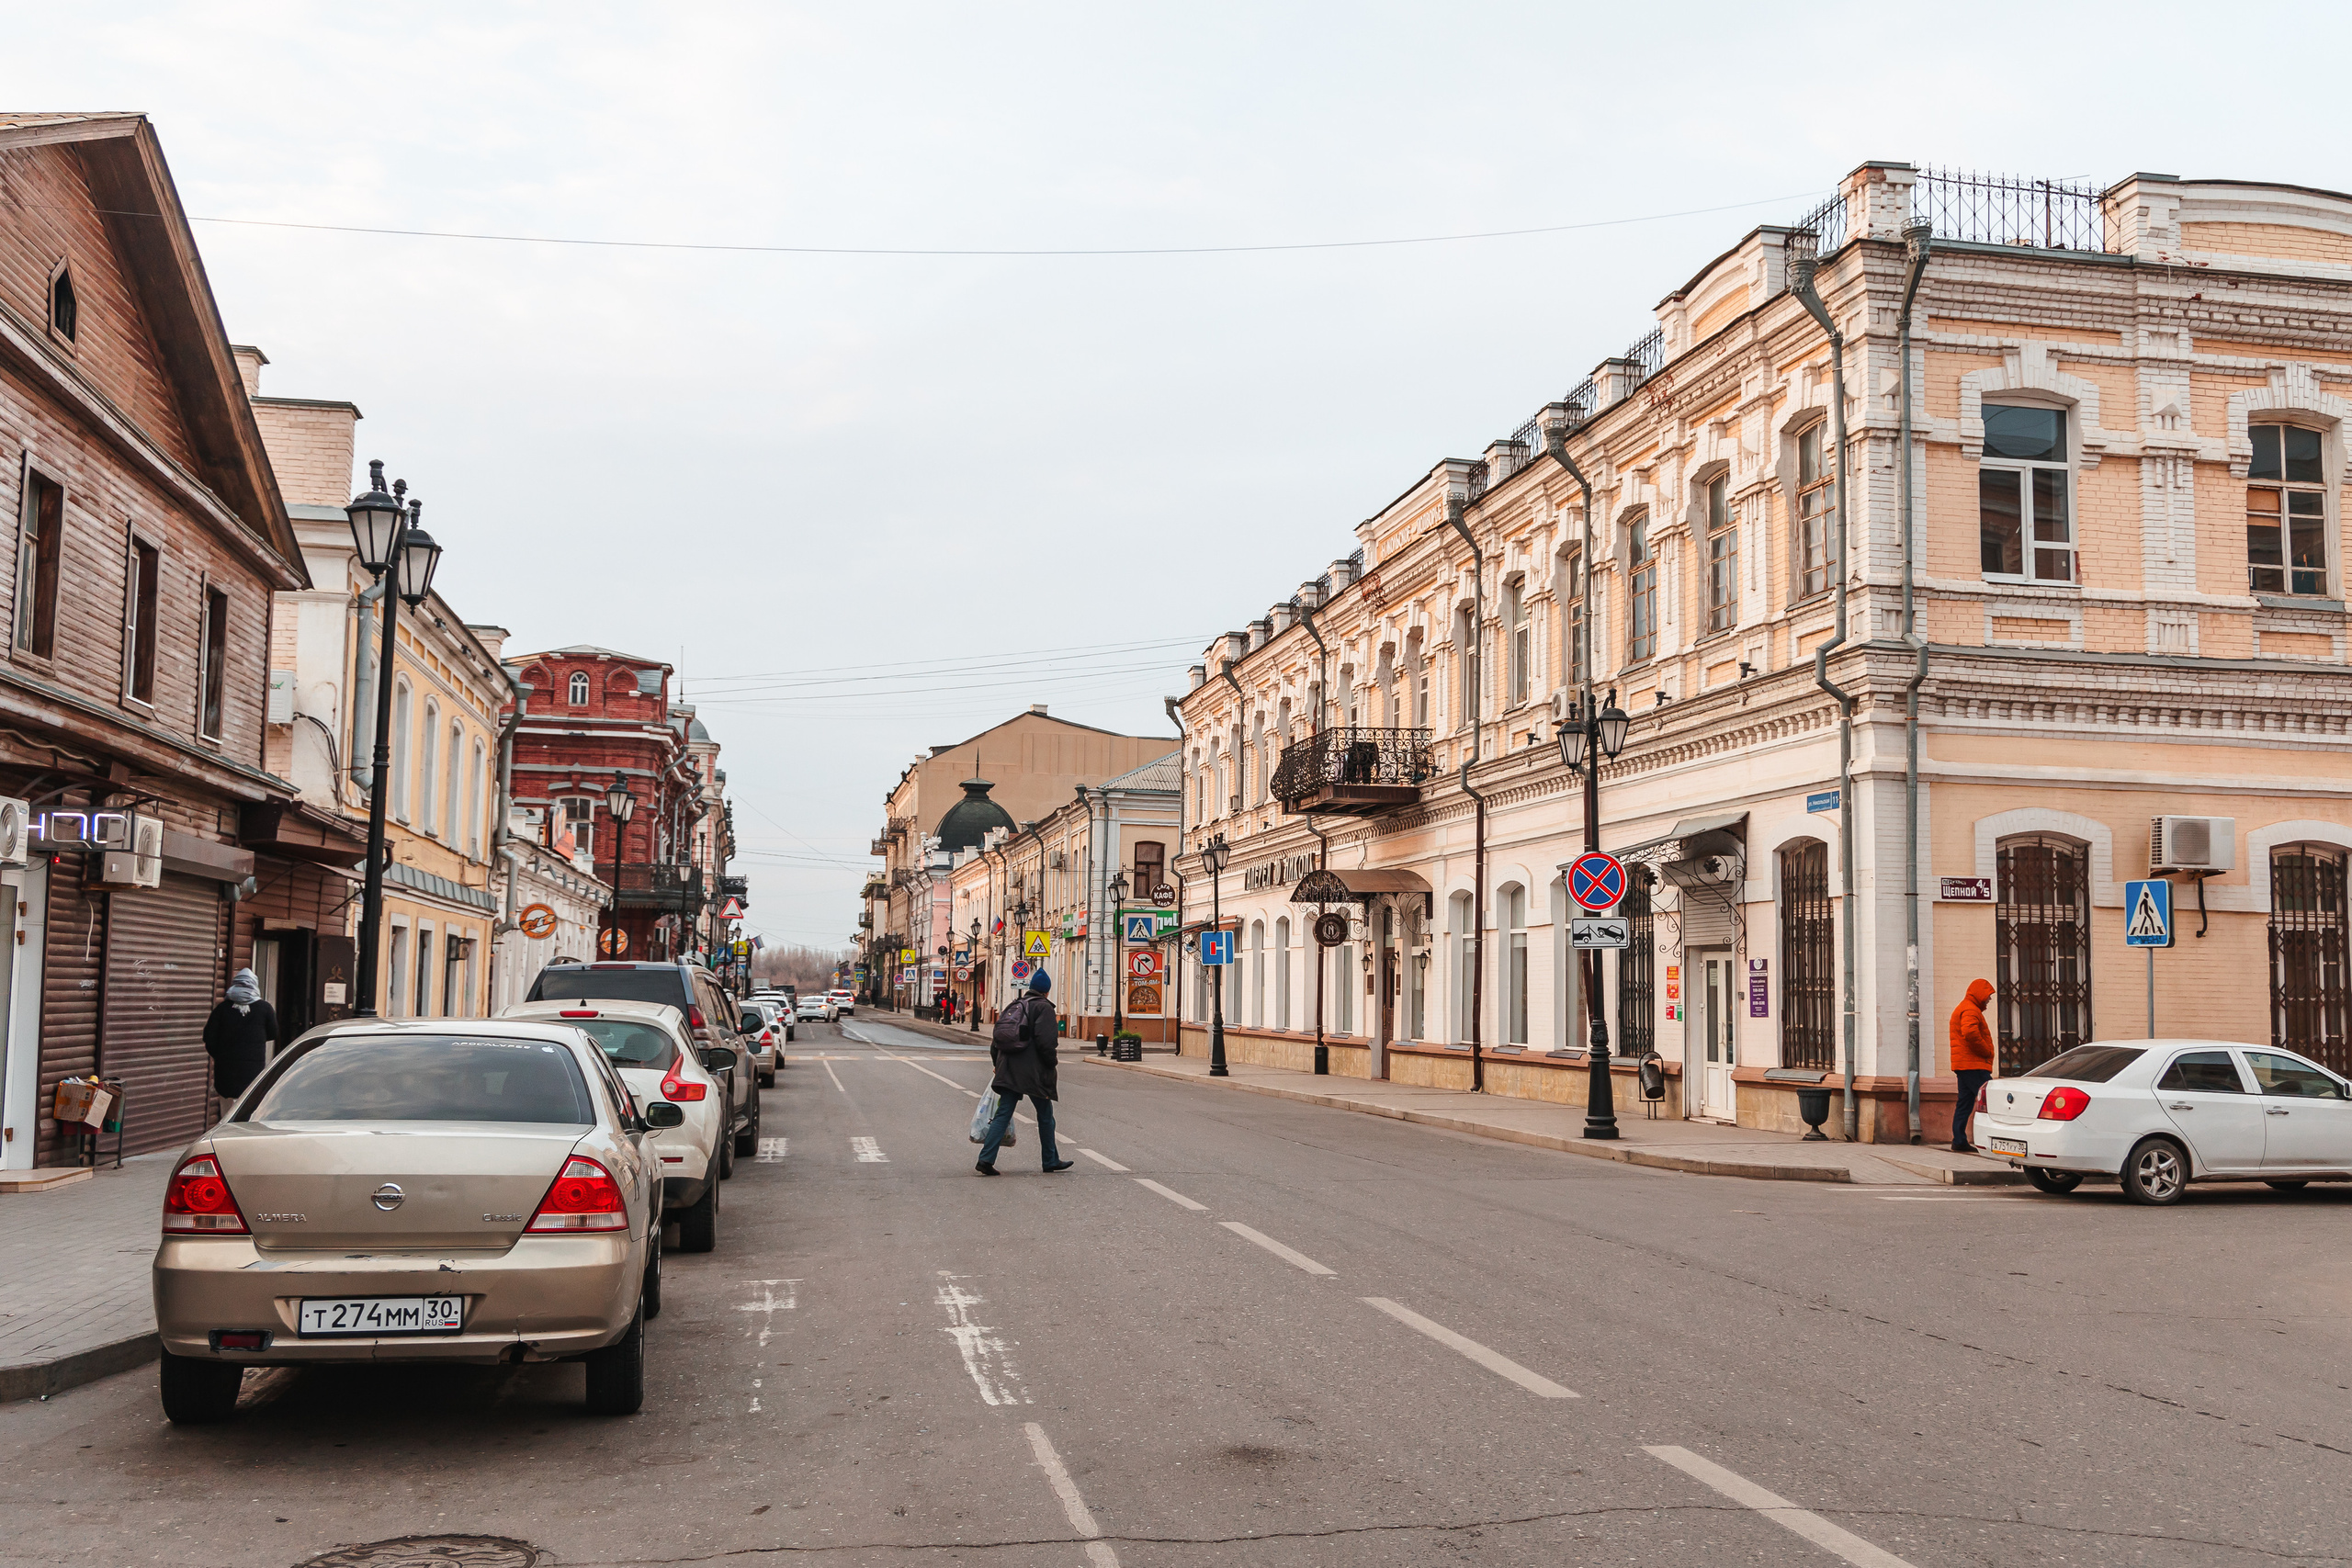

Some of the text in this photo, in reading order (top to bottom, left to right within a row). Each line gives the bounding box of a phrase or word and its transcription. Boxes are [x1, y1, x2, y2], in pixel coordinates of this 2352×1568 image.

[1833, 795, 1838, 805] 11
[1942, 886, 1977, 897] ЩЕПНОЙ
[255, 1213, 522, 1223] ALMERA Classic
[313, 1300, 453, 1328] Т274ММ 30
